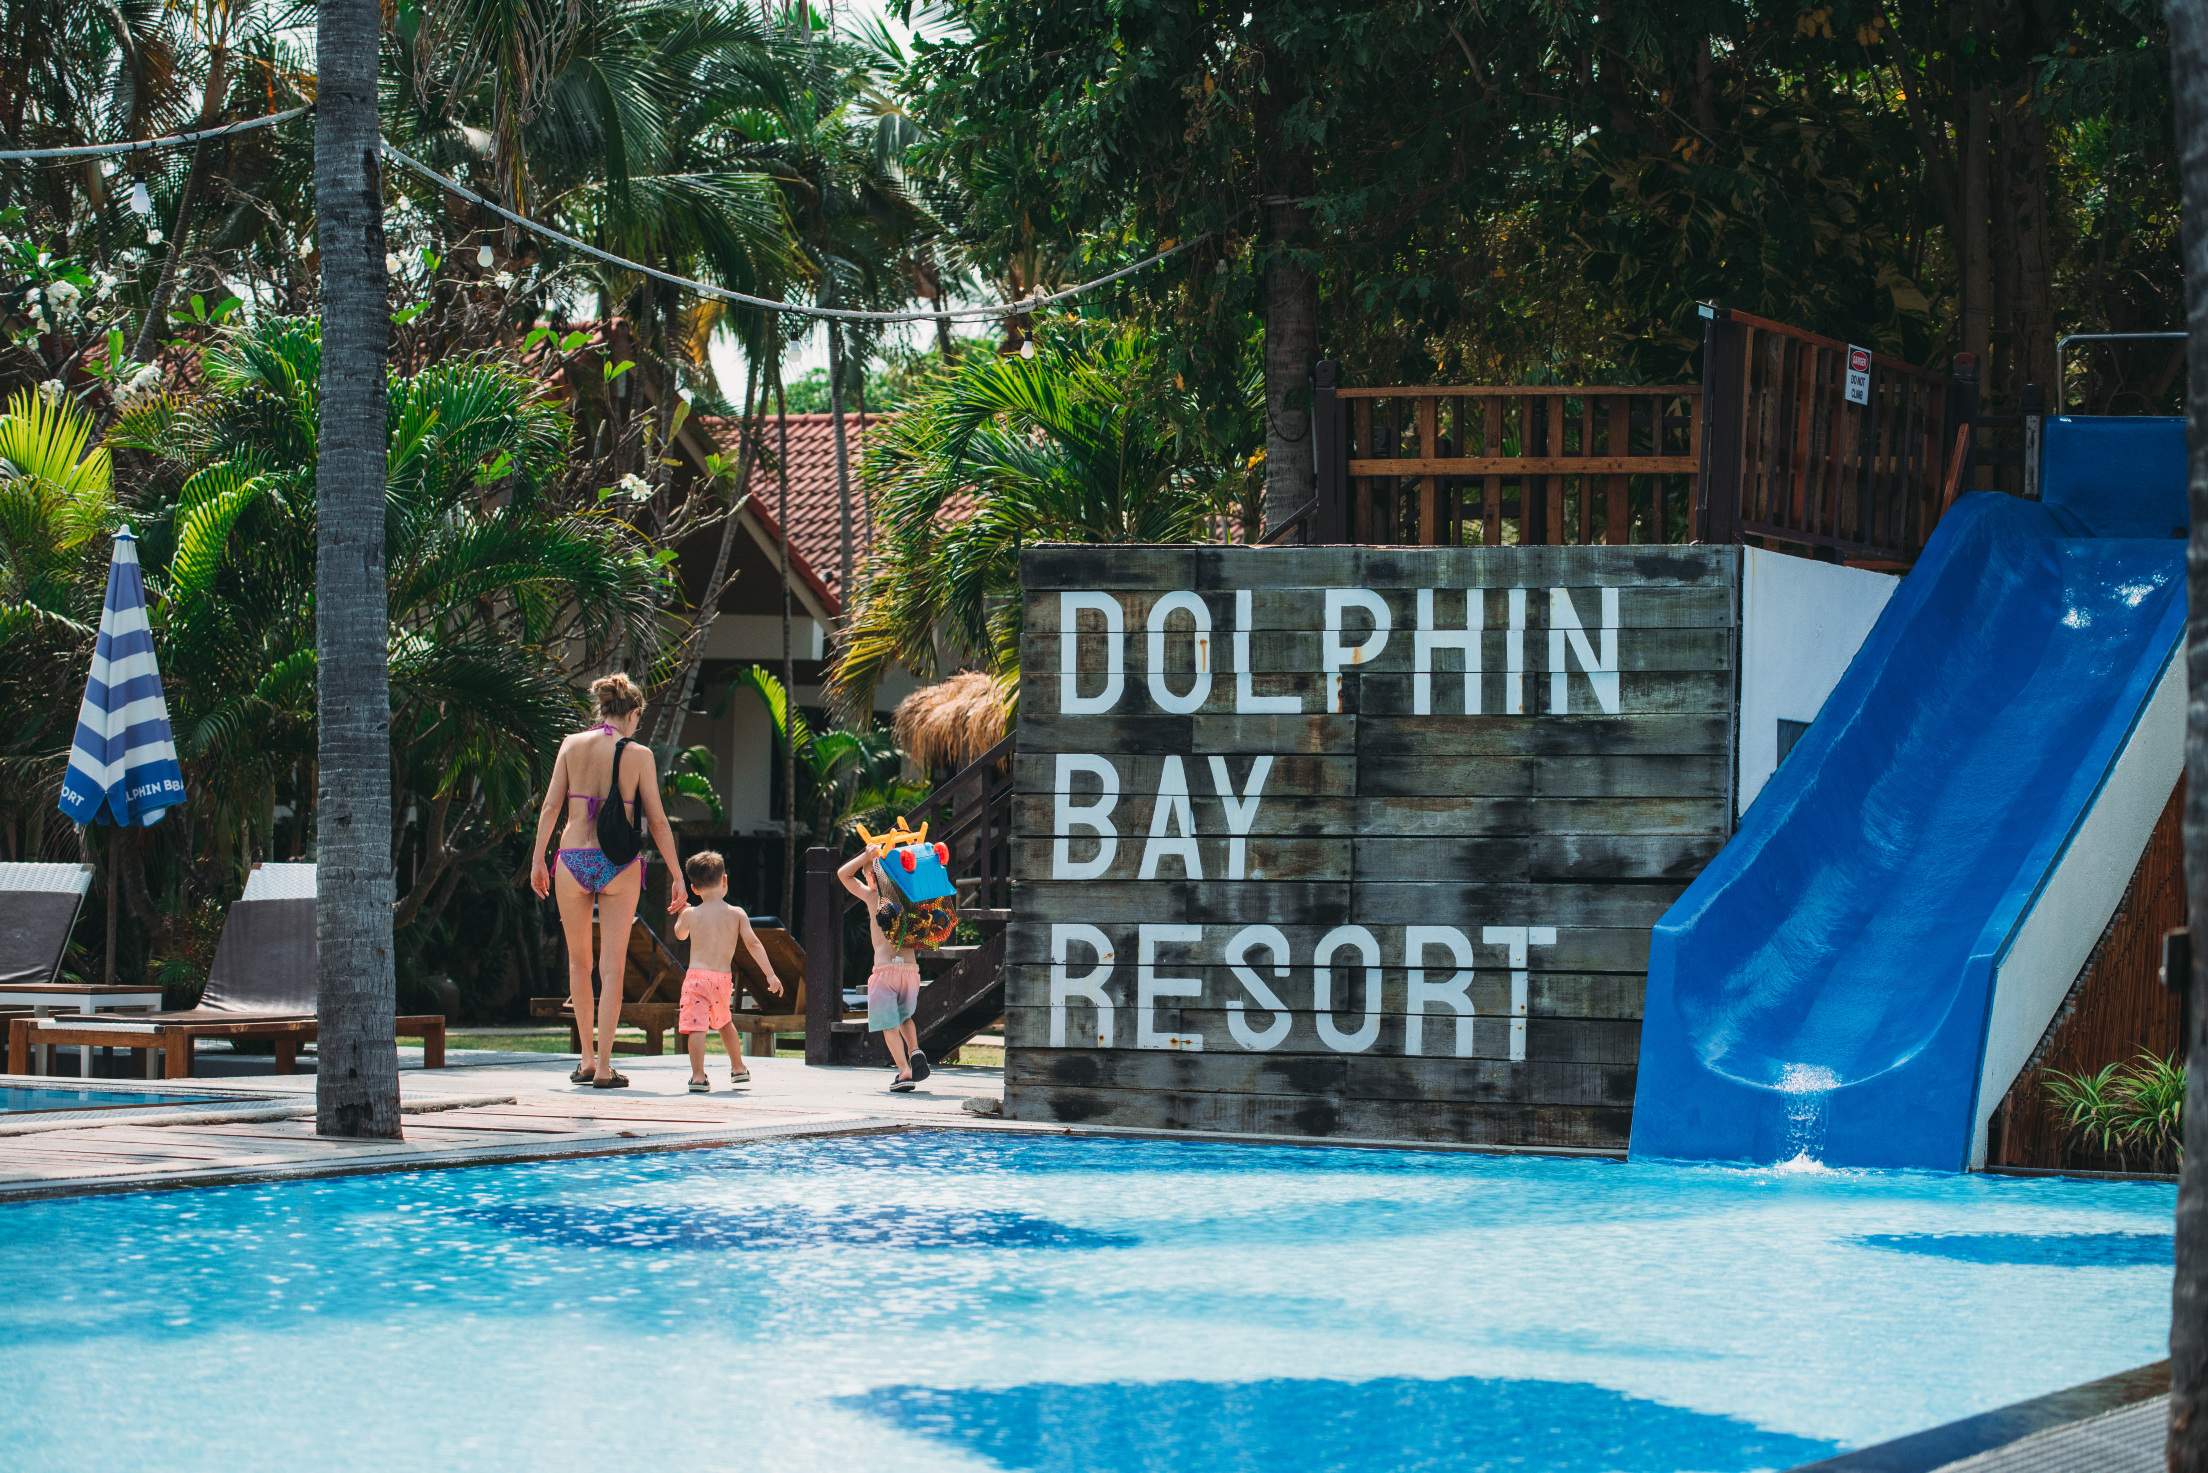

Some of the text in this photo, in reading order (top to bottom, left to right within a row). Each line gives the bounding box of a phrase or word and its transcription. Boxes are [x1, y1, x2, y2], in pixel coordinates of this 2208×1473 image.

[1857, 376, 1865, 387] NOT
[1851, 388, 1863, 400] CLIMB
[1060, 587, 1620, 715] DOLPHIN
[61, 784, 85, 806] ORT
[125, 781, 161, 803] LPHIN
[1052, 753, 1274, 880] BAY
[1049, 923, 1556, 1061] RESORT
